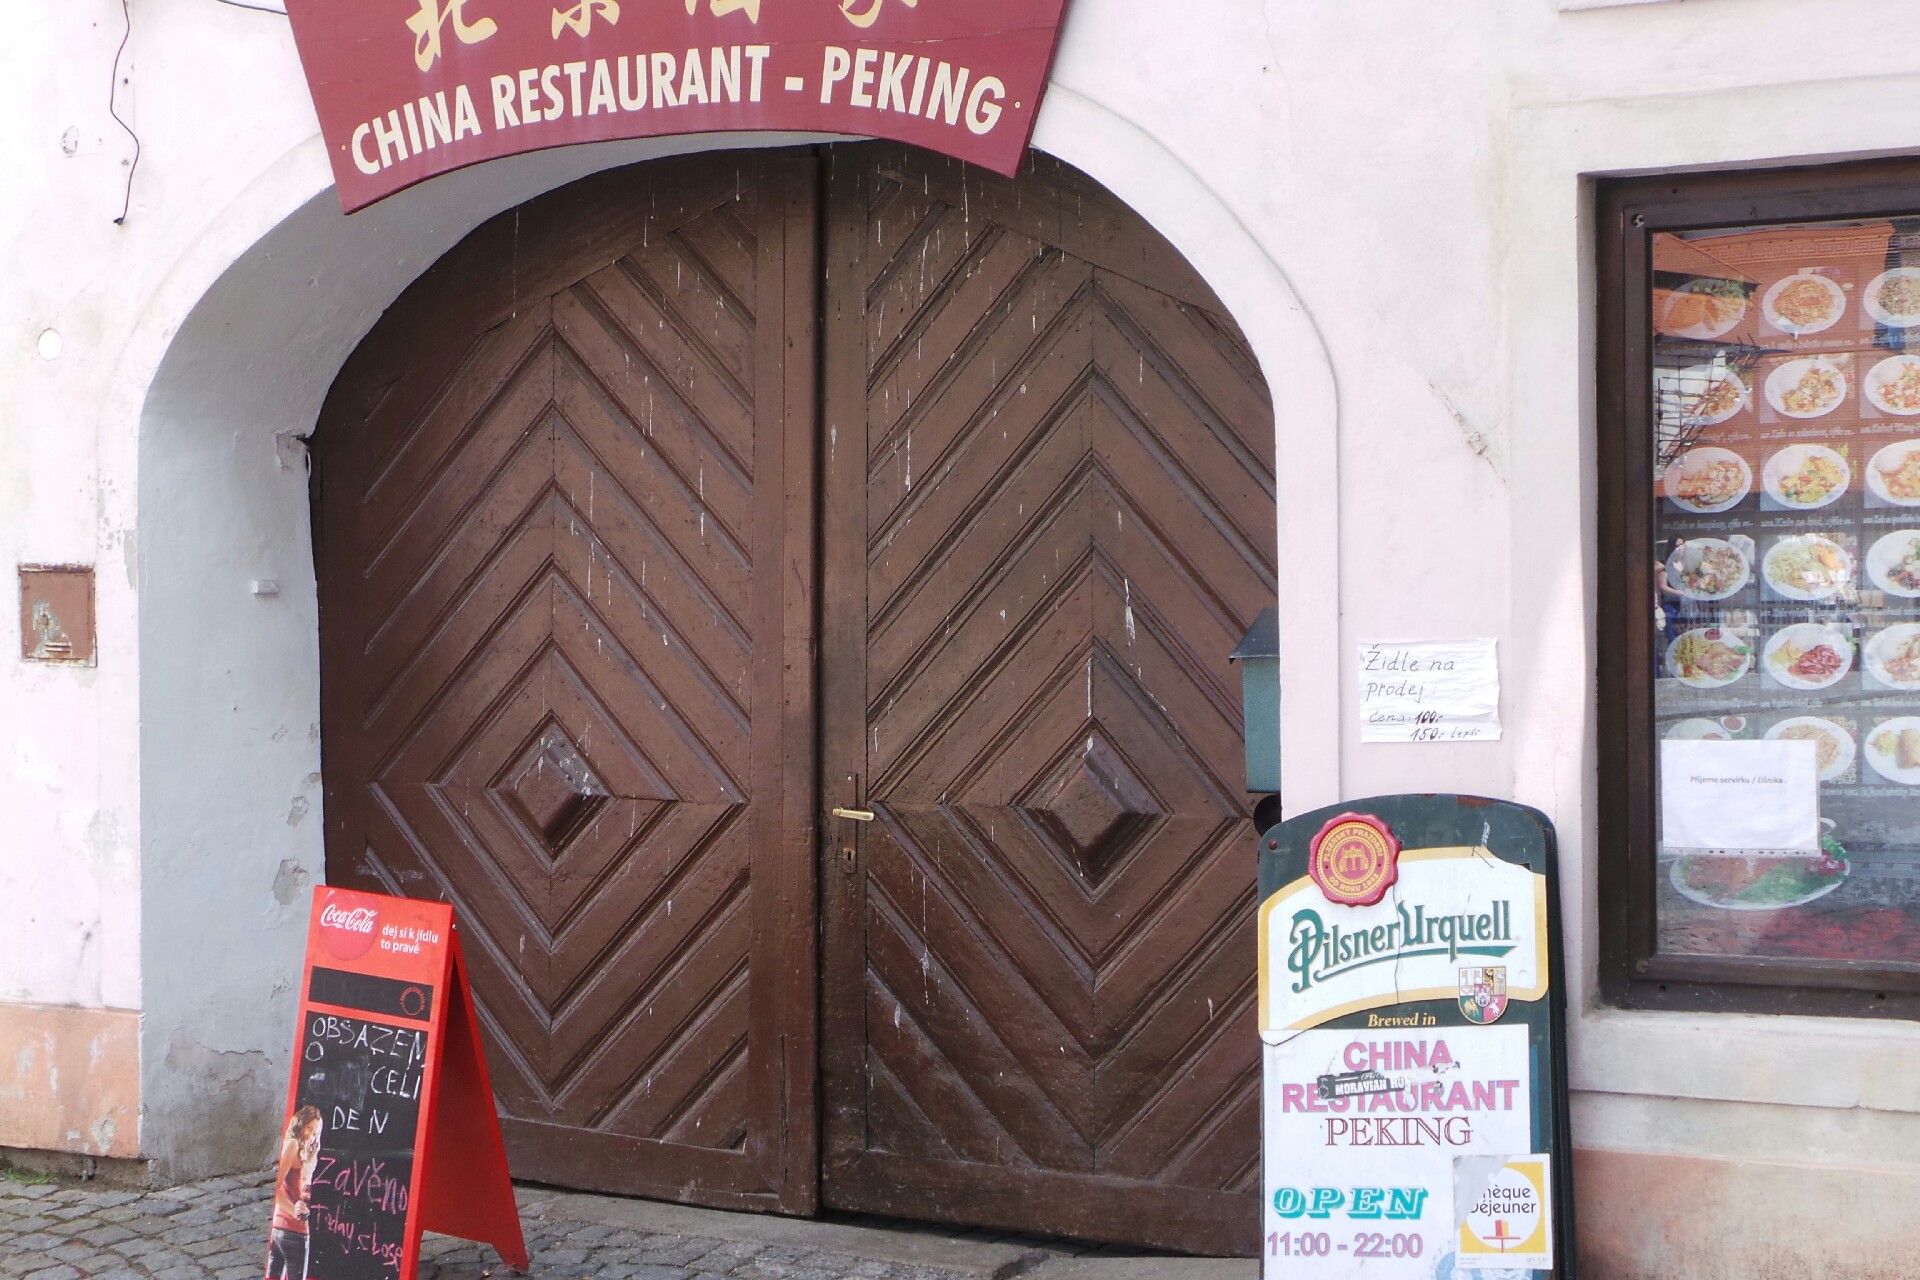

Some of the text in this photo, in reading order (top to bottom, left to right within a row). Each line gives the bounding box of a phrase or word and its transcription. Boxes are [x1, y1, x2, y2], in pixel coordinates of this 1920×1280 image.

[351, 84, 482, 175] CHINA
[490, 45, 770, 130] RESTAURANT
[820, 45, 1006, 135] PEKING
[1365, 643, 1455, 672] Židle na
[1329, 876, 1340, 887] OD
[1339, 884, 1361, 893] ROKU
[320, 903, 379, 934] Coca-Cola
[382, 924, 397, 939] dej
[399, 927, 407, 939] si
[408, 928, 415, 940] k
[380, 939, 420, 955] to pravé
[1287, 900, 1512, 994] Pilsner Urquell
[1367, 1013, 1436, 1027] Brewed in
[1343, 1040, 1453, 1072] CHINA
[1335, 1079, 1387, 1096] MORAVIAN
[331, 1106, 389, 1134] DEN
[1325, 1116, 1472, 1146] PEKING
[1273, 1186, 1429, 1220] OPEN
[1267, 1232, 1331, 1256] 11:00
[1353, 1233, 1423, 1258] 22:00
